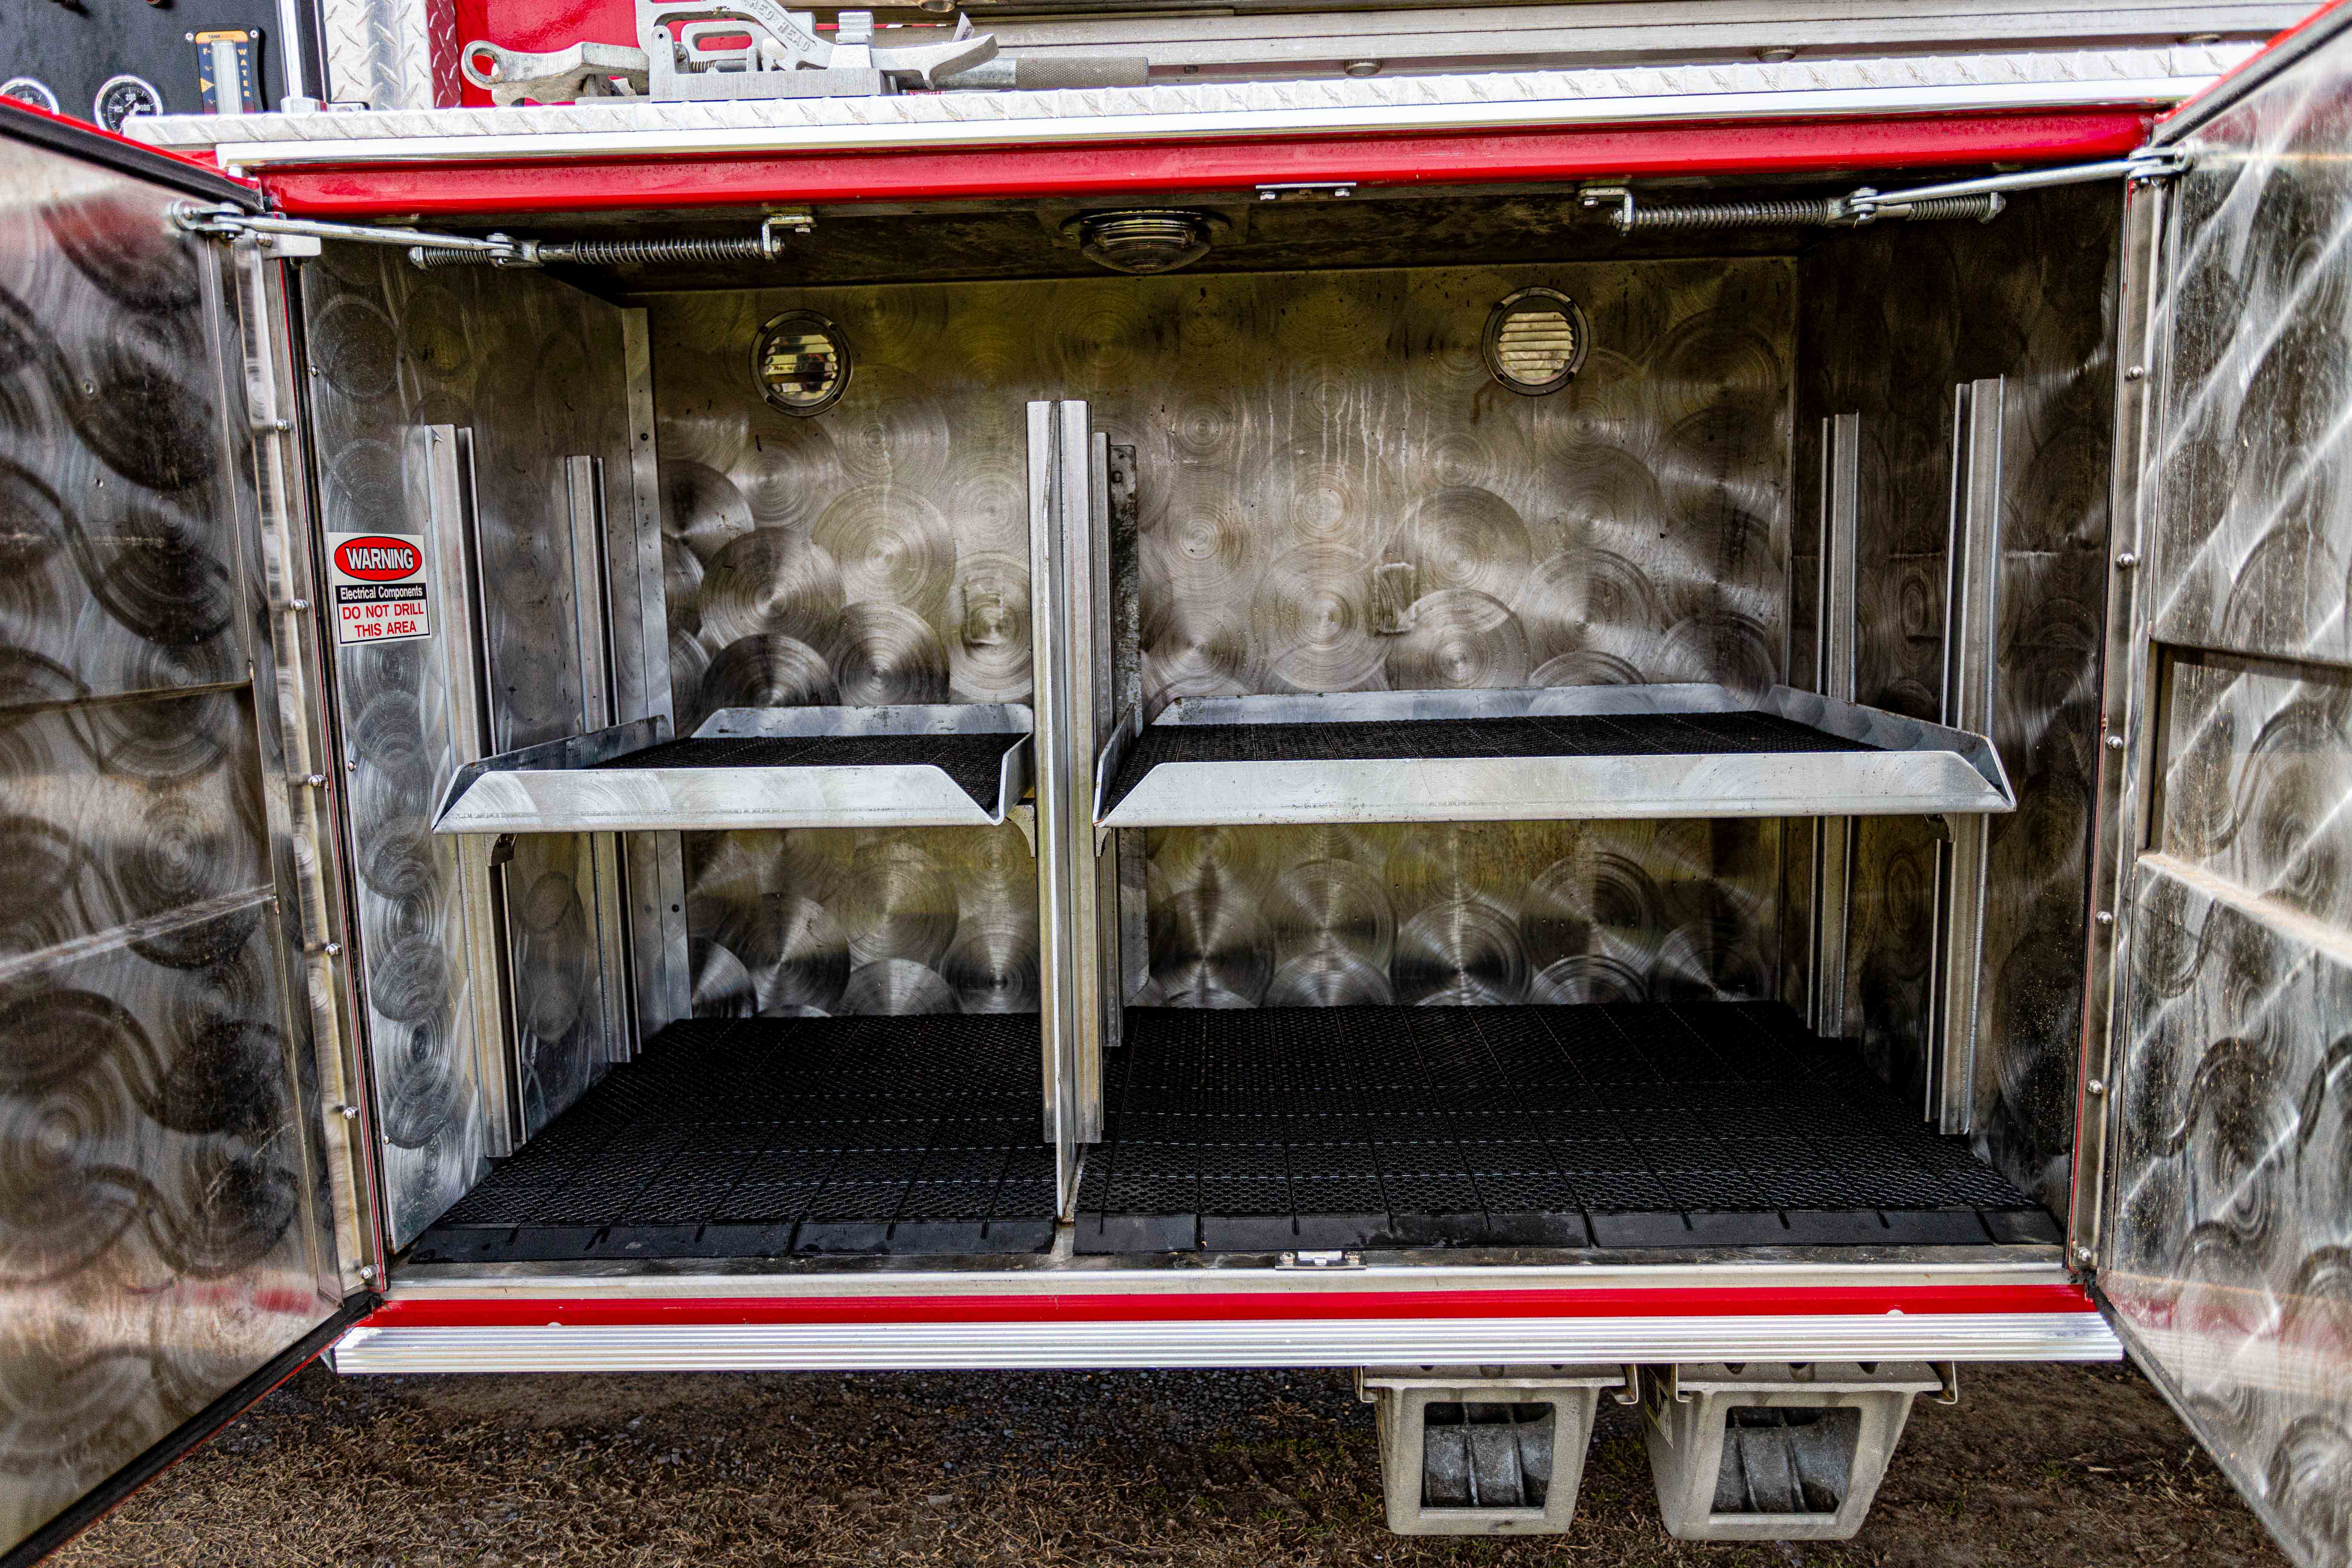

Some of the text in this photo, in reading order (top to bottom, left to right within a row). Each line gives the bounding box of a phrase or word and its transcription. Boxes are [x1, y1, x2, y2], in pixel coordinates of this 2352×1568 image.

[777, 22, 810, 52] HEAD
[237, 48, 250, 97] WATER
[345, 548, 414, 570] WARNING
[341, 585, 423, 600] Electrical Components
[343, 603, 424, 620] DO NOT DRILL
[355, 620, 416, 637] THIS AREA
